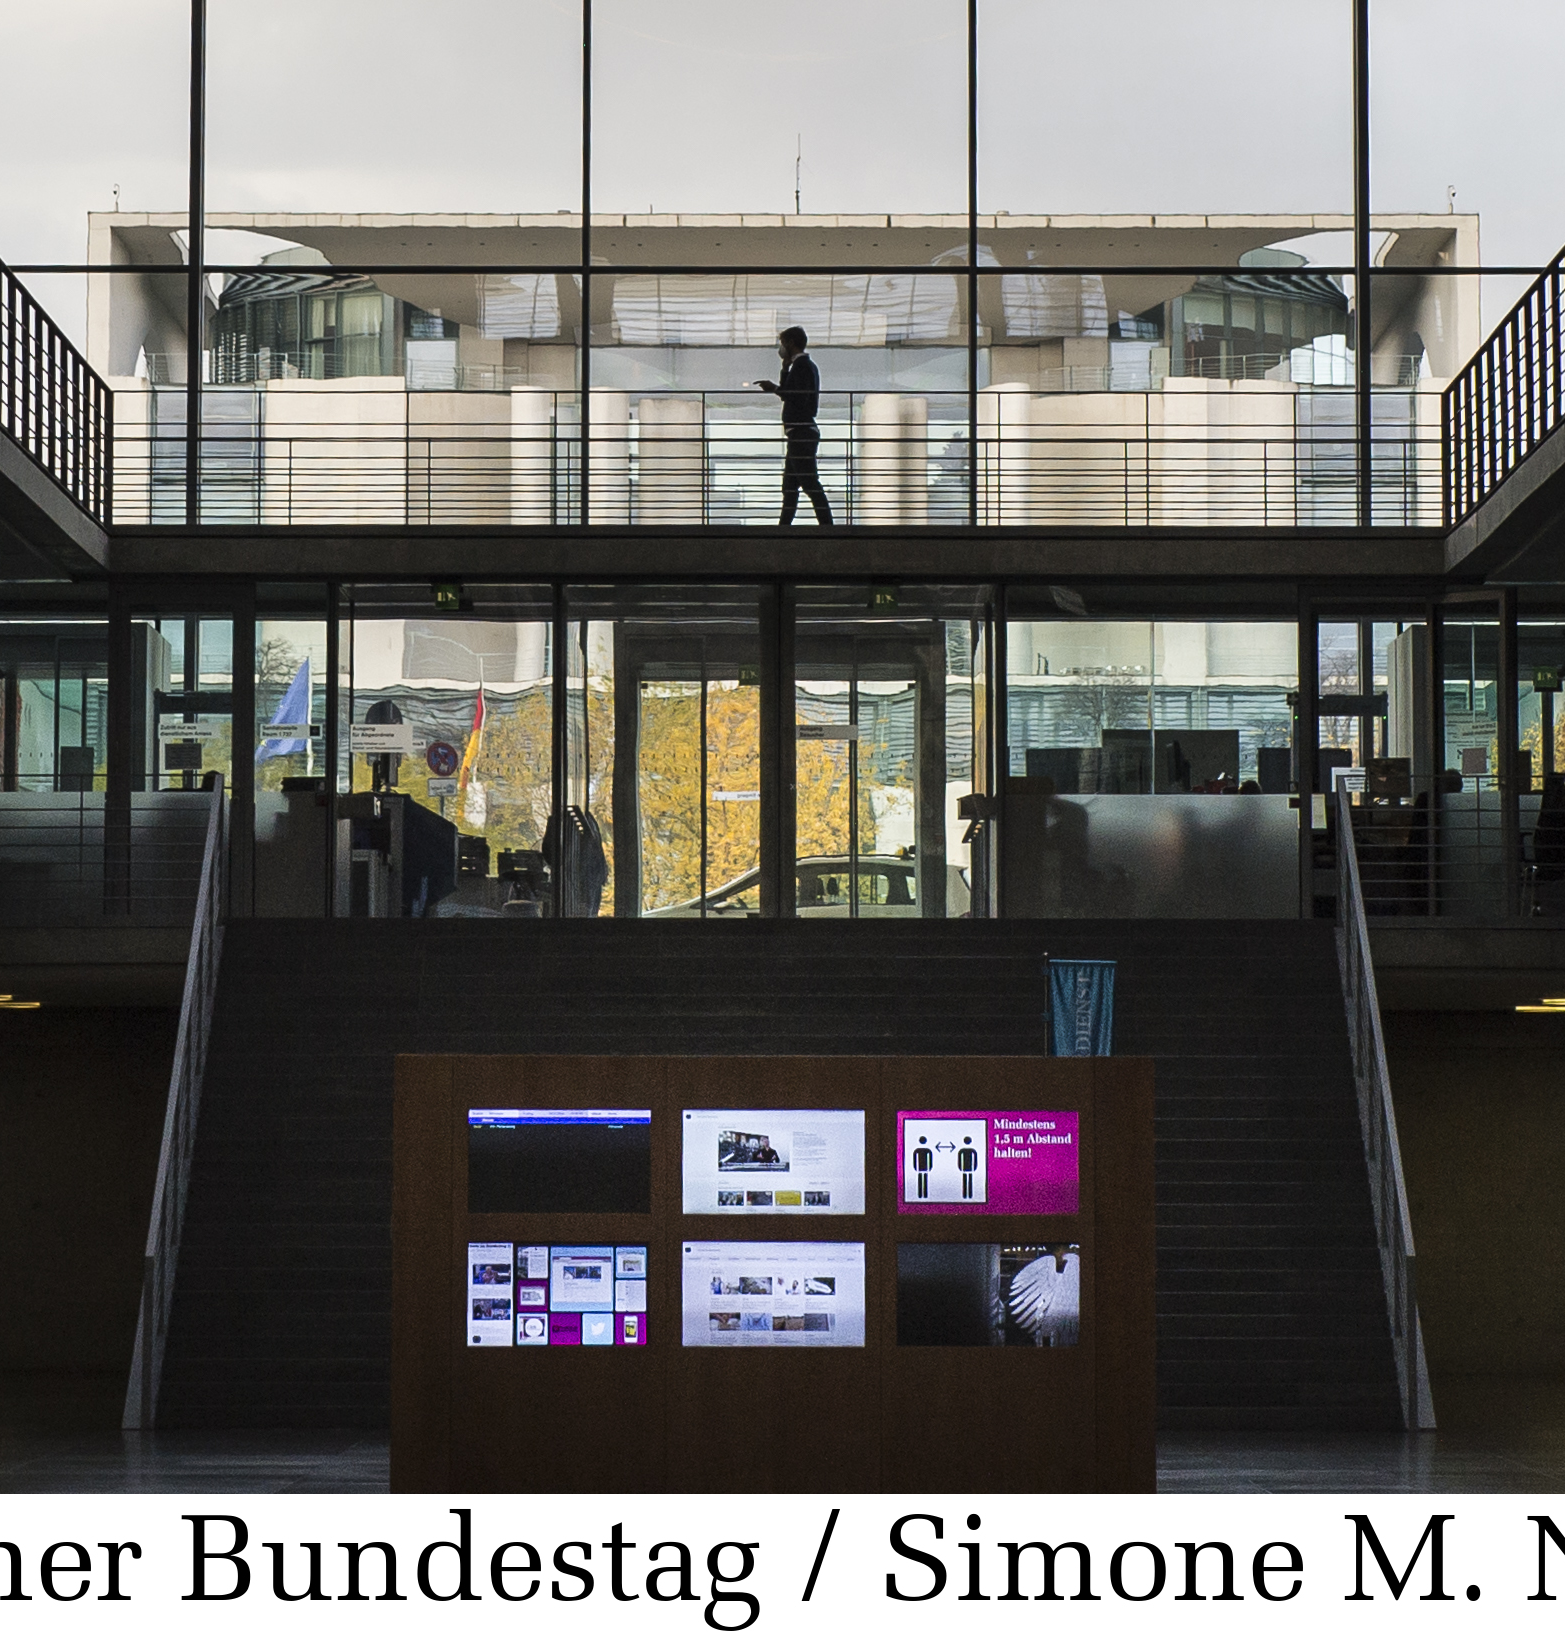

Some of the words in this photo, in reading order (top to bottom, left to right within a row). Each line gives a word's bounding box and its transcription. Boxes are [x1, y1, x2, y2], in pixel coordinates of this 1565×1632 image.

[994, 1118, 1056, 1130] Mindestens
[994, 1133, 1011, 1145] 1,5
[1013, 1135, 1024, 1144] m
[1027, 1132, 1073, 1144] Abstand
[994, 1146, 1032, 1158] halten!
